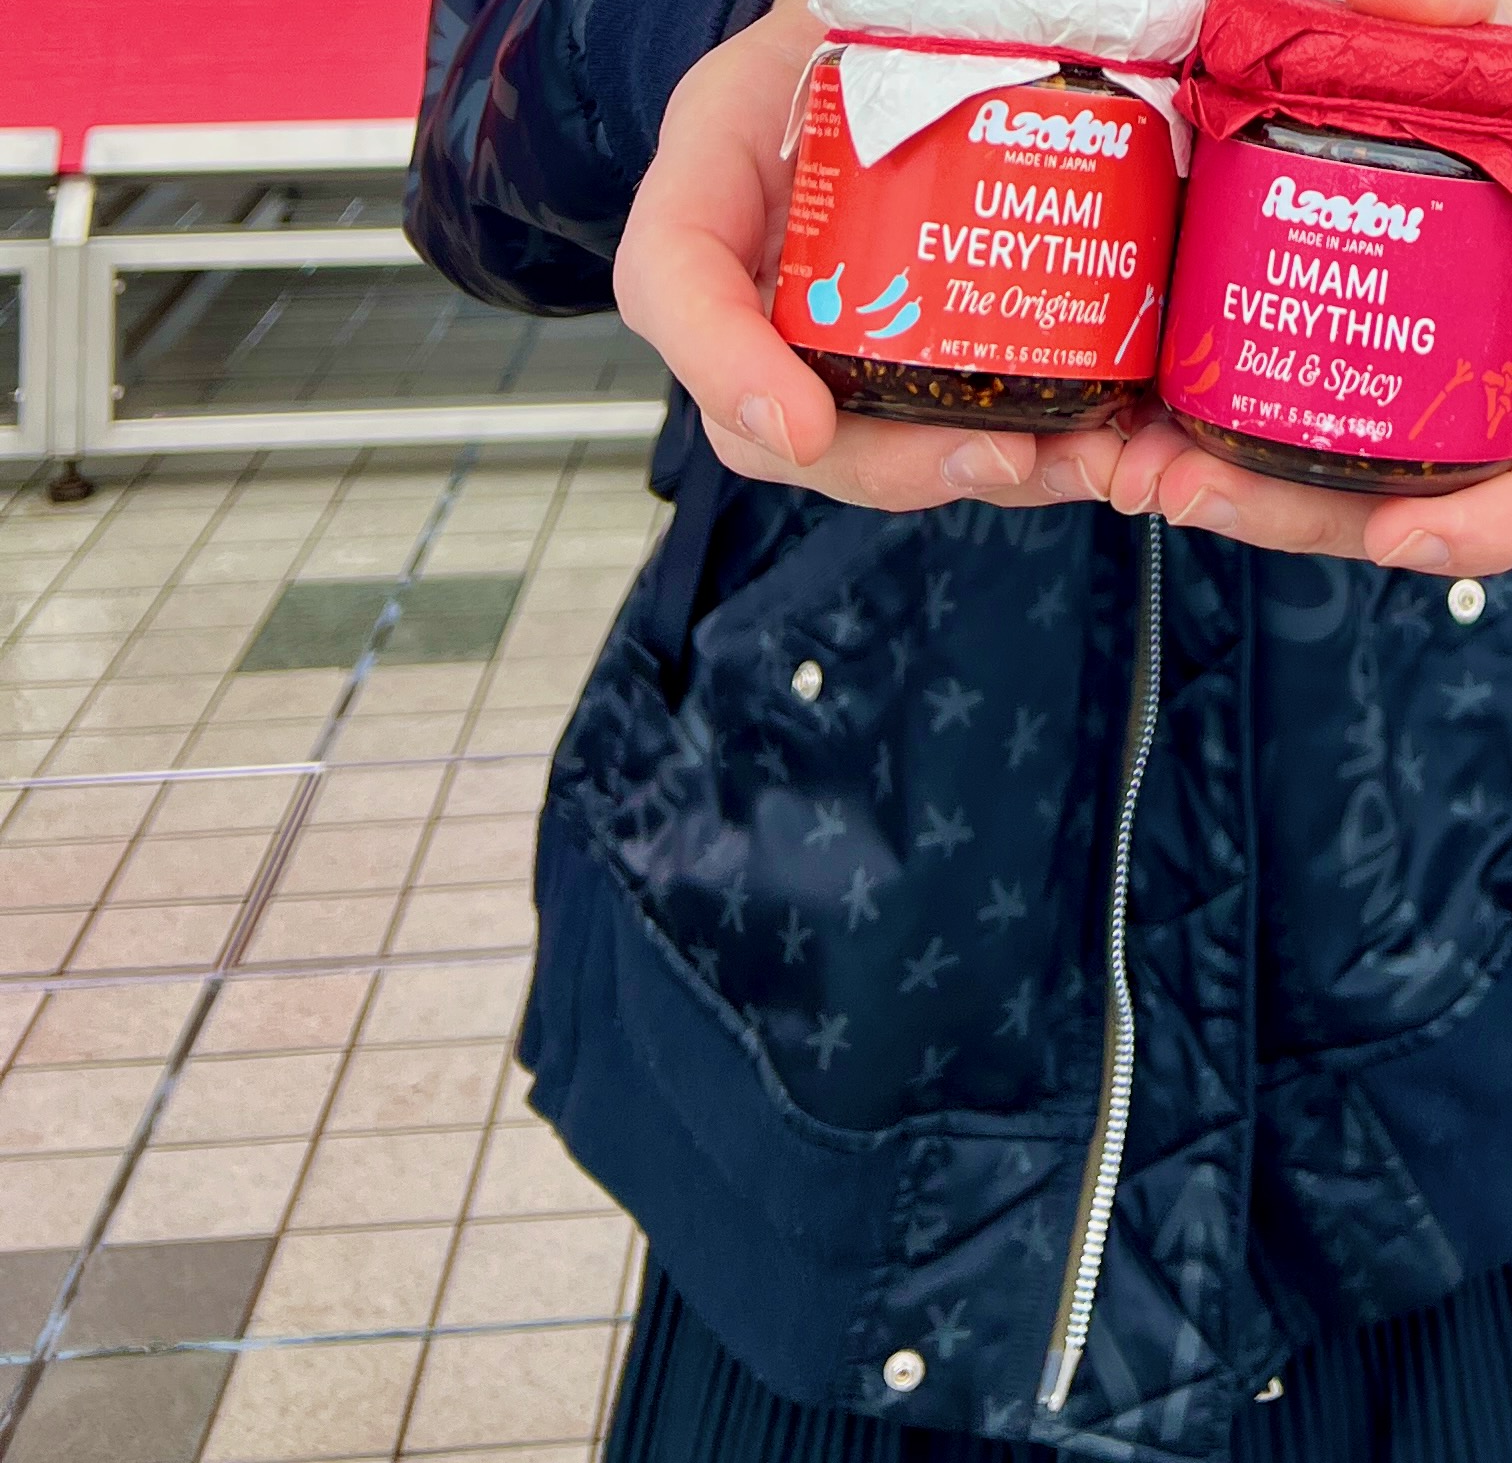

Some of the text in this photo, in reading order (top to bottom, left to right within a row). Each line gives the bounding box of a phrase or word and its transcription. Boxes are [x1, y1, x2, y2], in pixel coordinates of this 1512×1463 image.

[1004, 150, 1097, 173] MADE IN JAPAN
[975, 180, 1103, 230] UMAMI
[917, 221, 1138, 279] EVERYTHING
[1288, 228, 1384, 257] MADE IN JAPAN
[1267, 248, 1389, 306] UMAMI
[943, 278, 1110, 329] The Original
[1223, 282, 1436, 355] EVERYTHING
[940, 339, 970, 356] NET
[973, 343, 1000, 359] WT.
[1032, 347, 1051, 364] OZ
[1235, 339, 1403, 407] Bold & Spicy
[1232, 393, 1256, 413] NET
[1259, 399, 1284, 420] WT.
